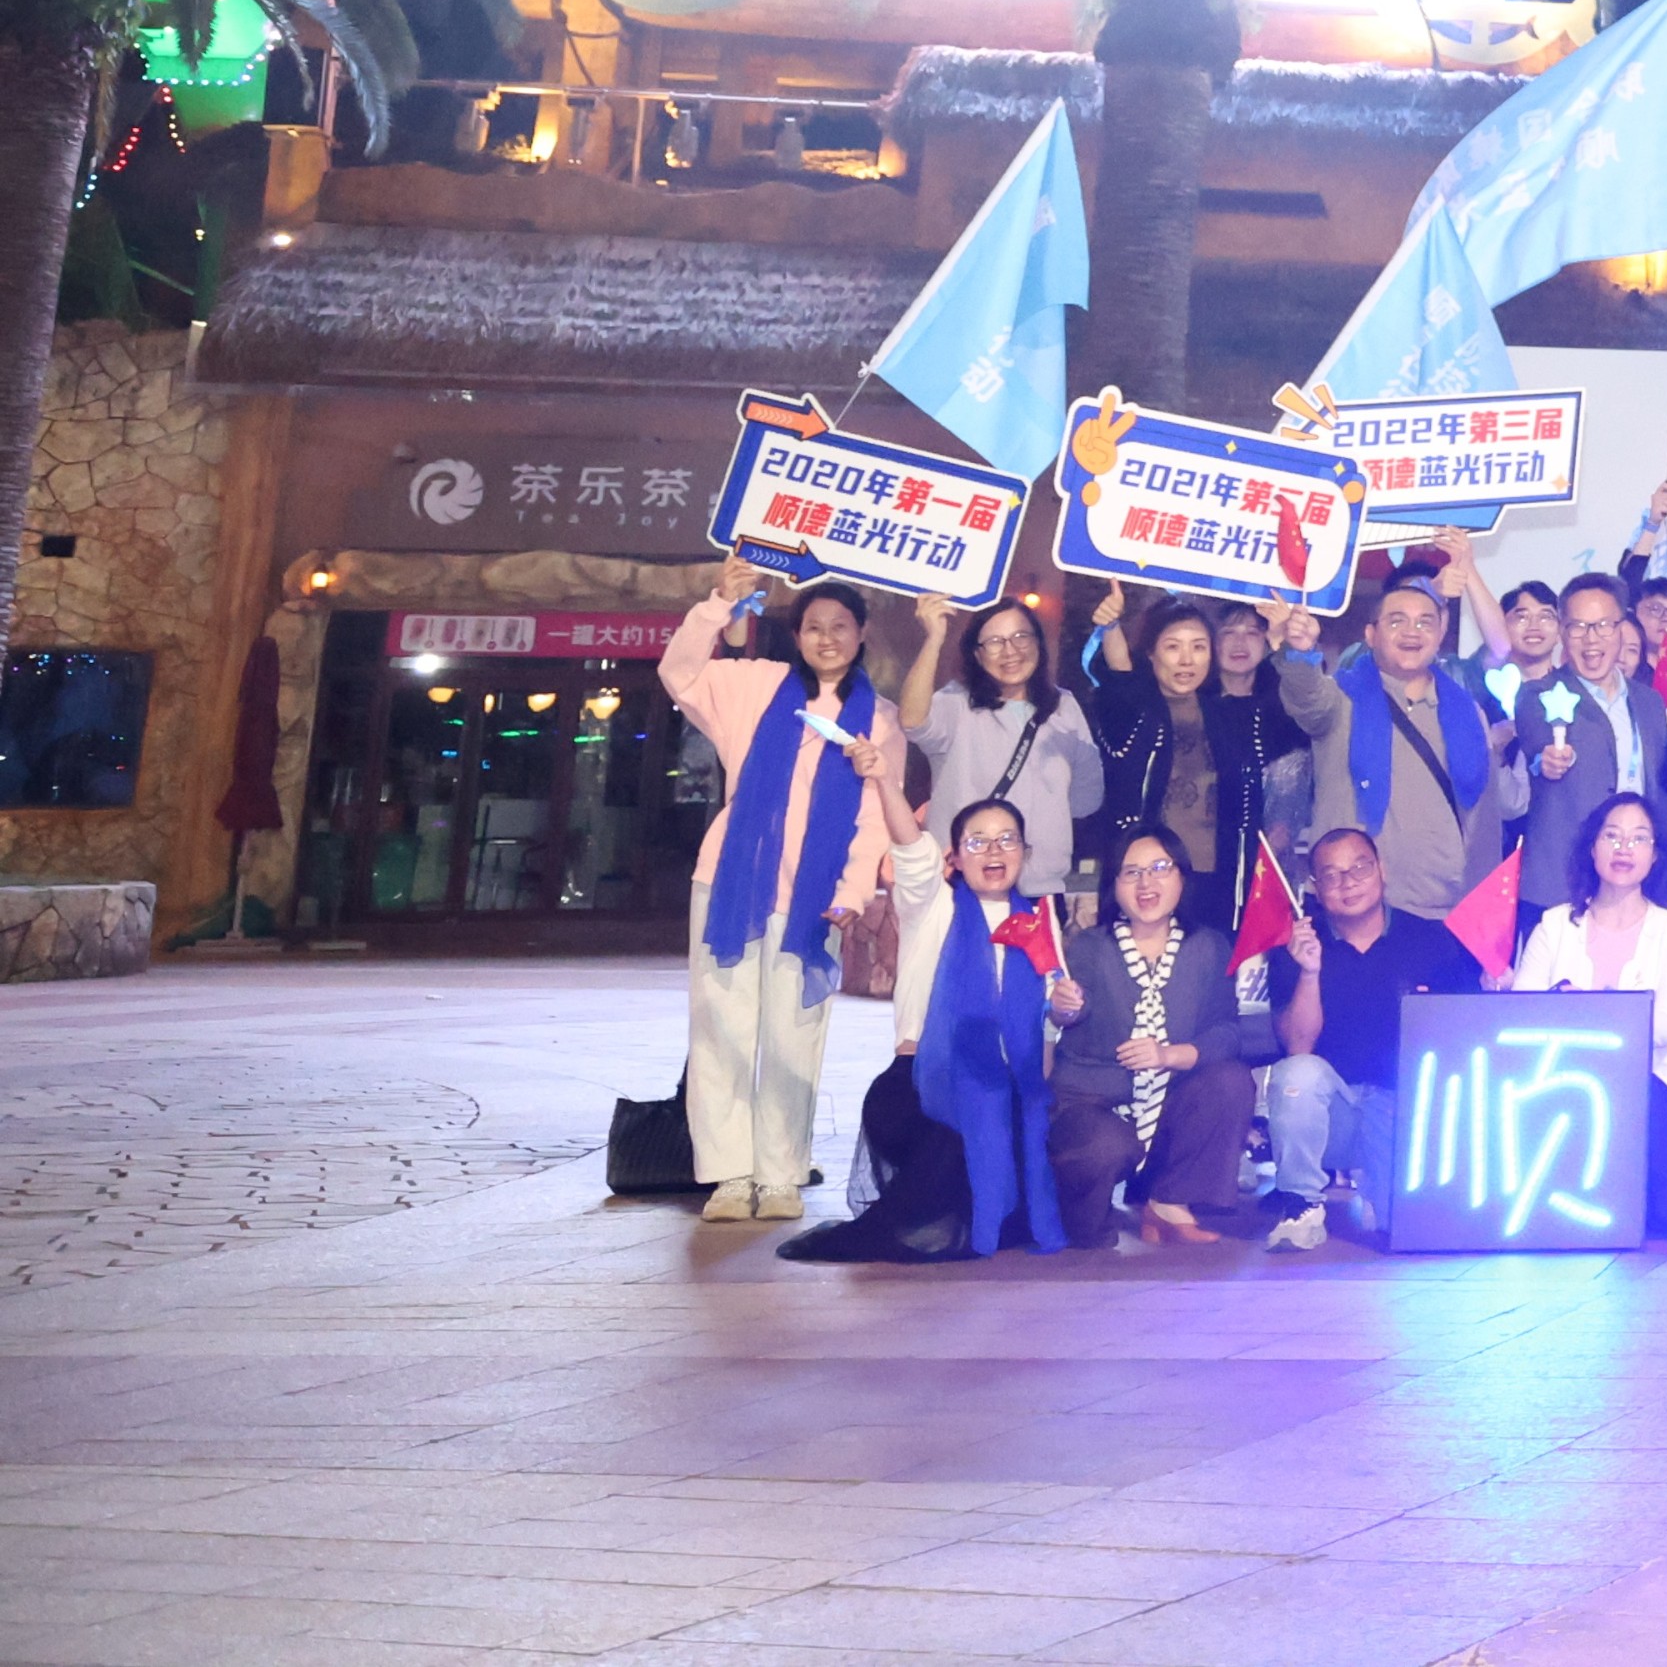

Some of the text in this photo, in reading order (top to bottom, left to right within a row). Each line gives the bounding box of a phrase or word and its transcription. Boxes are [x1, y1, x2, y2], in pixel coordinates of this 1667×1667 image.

[1333, 408, 1563, 448] 2022年第三届
[760, 446, 1004, 533] 2020年第一届
[761, 491, 968, 572] 顺德蓝光行动
[1119, 505, 1313, 564] 顺德蓝光行
[1405, 1028, 1624, 1237] 顺
